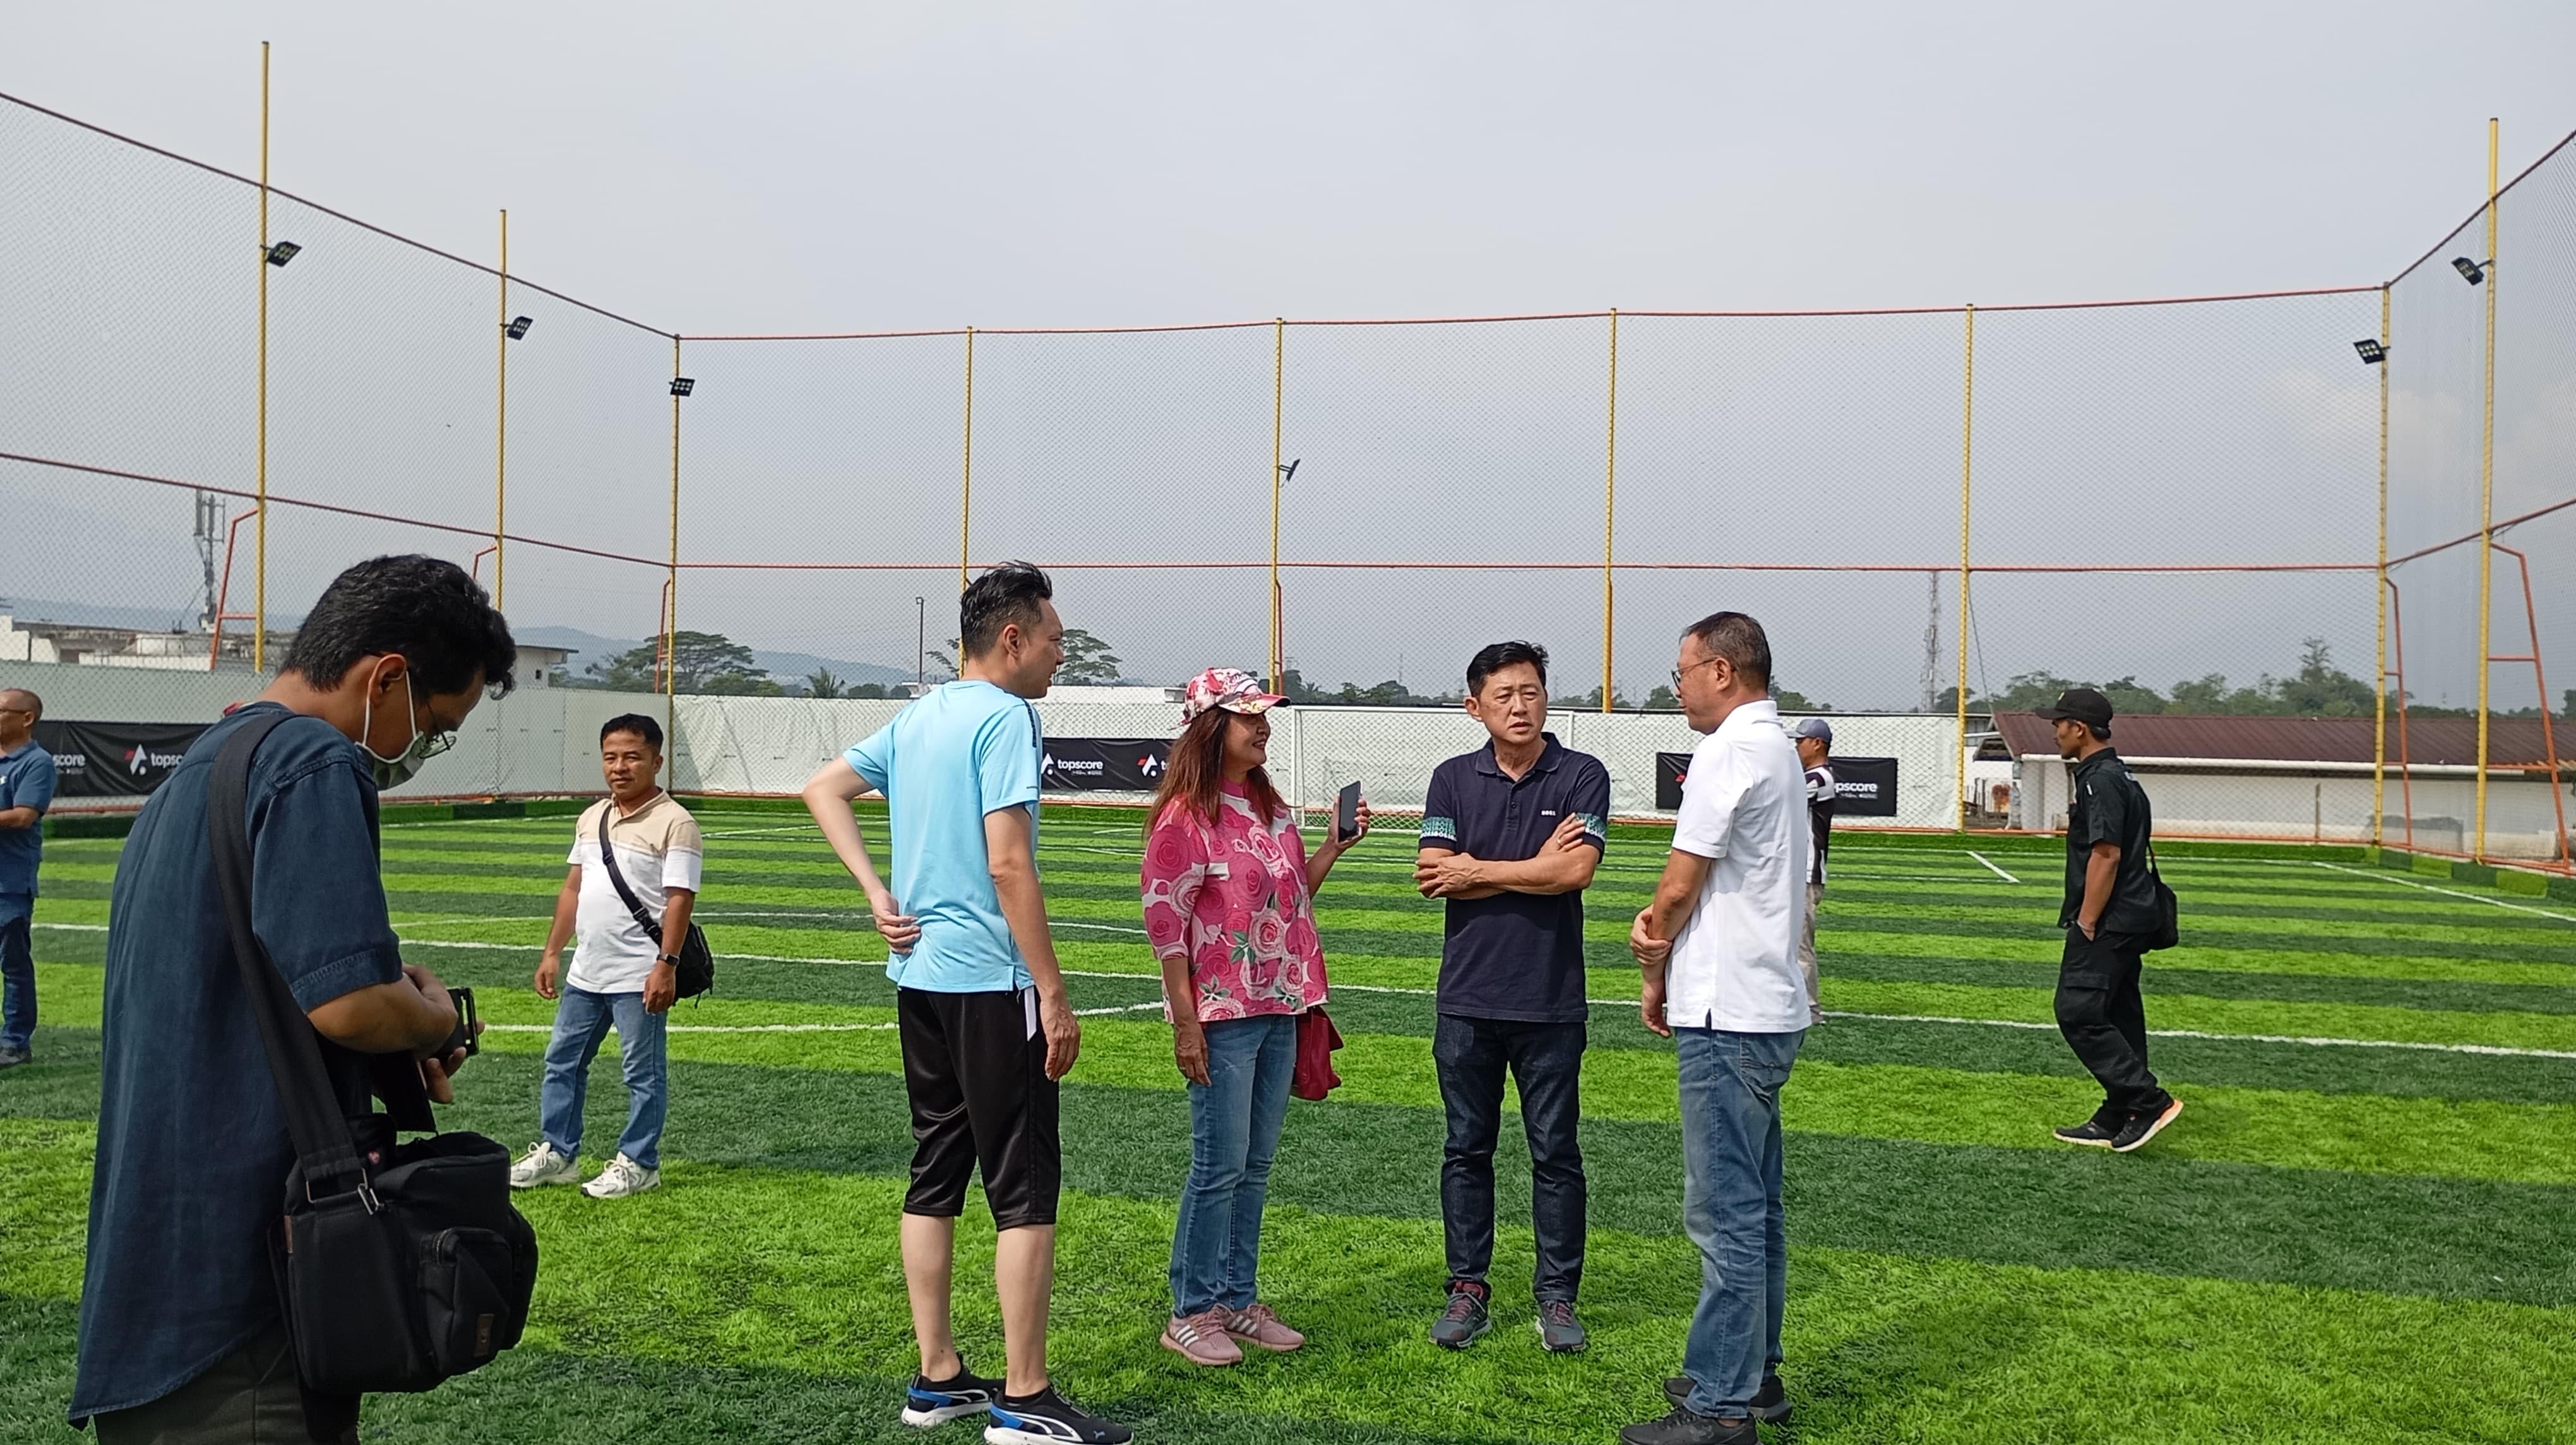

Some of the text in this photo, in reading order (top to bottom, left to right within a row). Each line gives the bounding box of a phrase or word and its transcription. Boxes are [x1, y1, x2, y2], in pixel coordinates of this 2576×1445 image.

[52, 754, 86, 766] score
[151, 752, 183, 769] topsc
[1058, 758, 1104, 771] topscore
[1834, 782, 1878, 793] pscore
